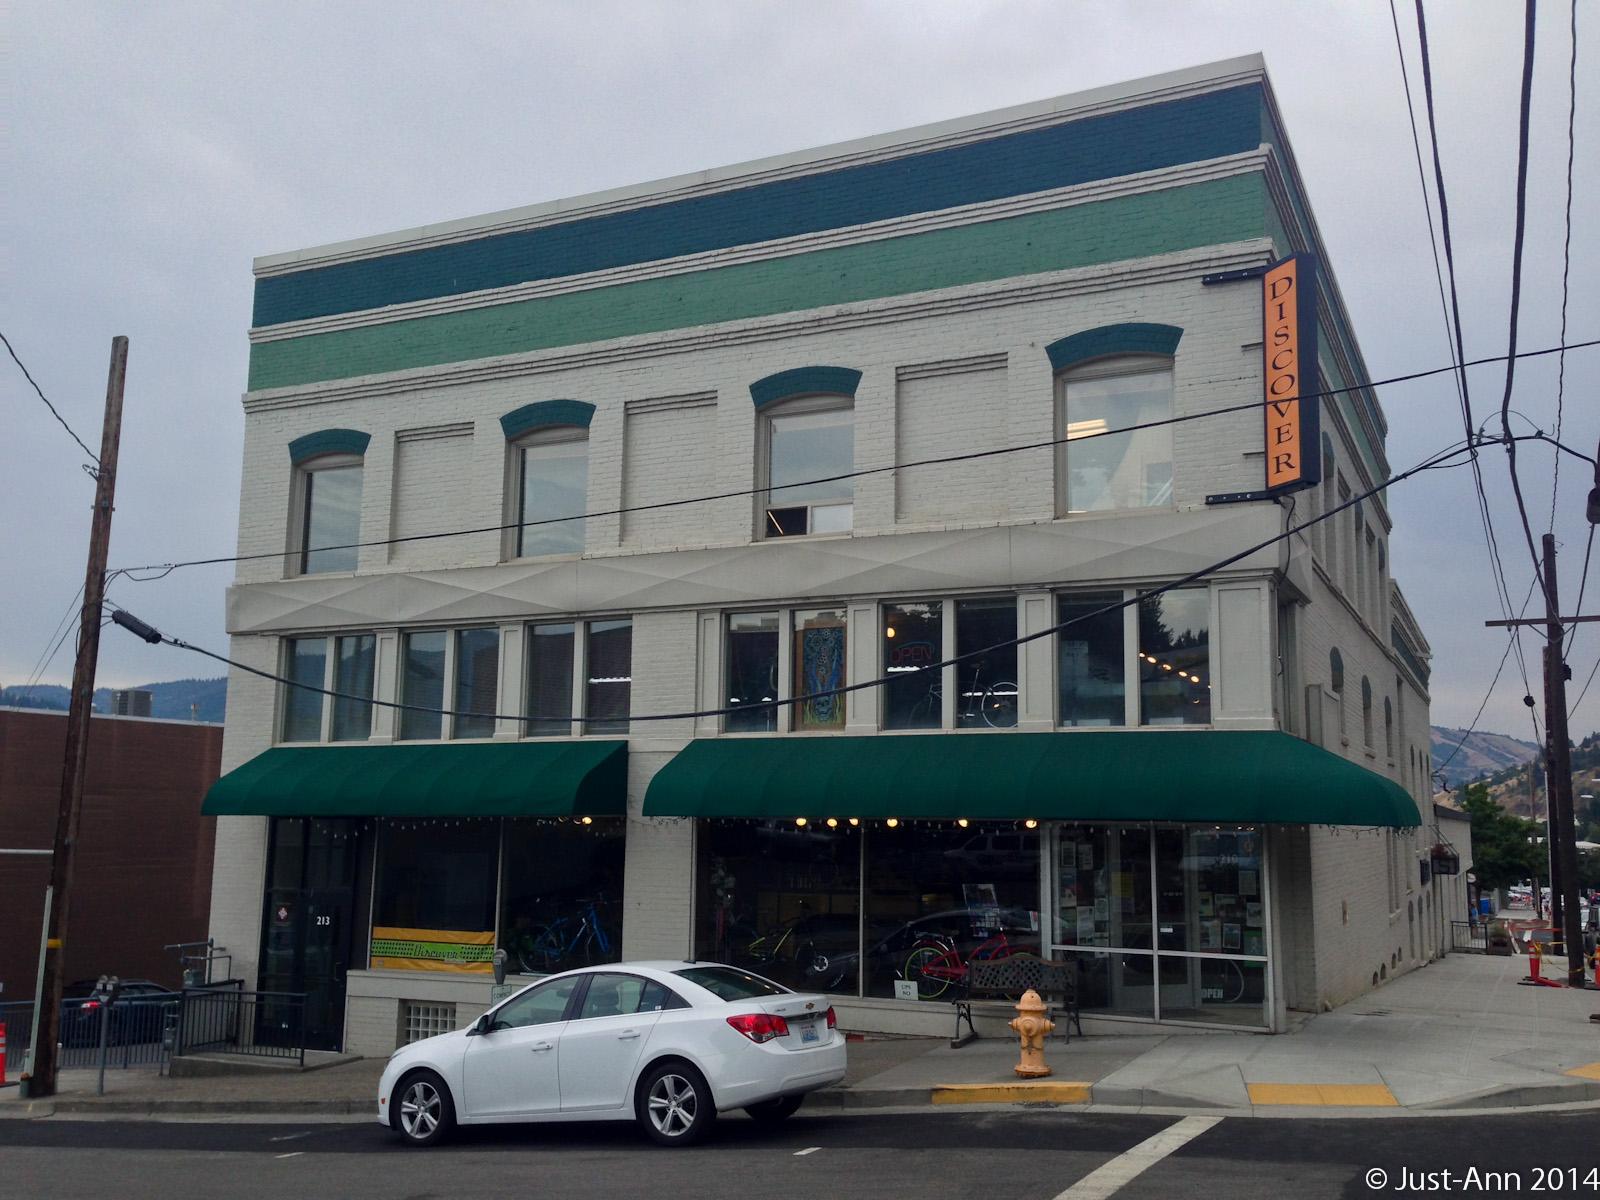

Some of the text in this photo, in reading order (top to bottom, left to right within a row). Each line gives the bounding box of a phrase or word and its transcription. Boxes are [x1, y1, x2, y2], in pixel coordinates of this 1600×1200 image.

[1269, 277, 1295, 474] DISCOVER
[890, 646, 932, 663] OPEN
[316, 916, 330, 926] 213
